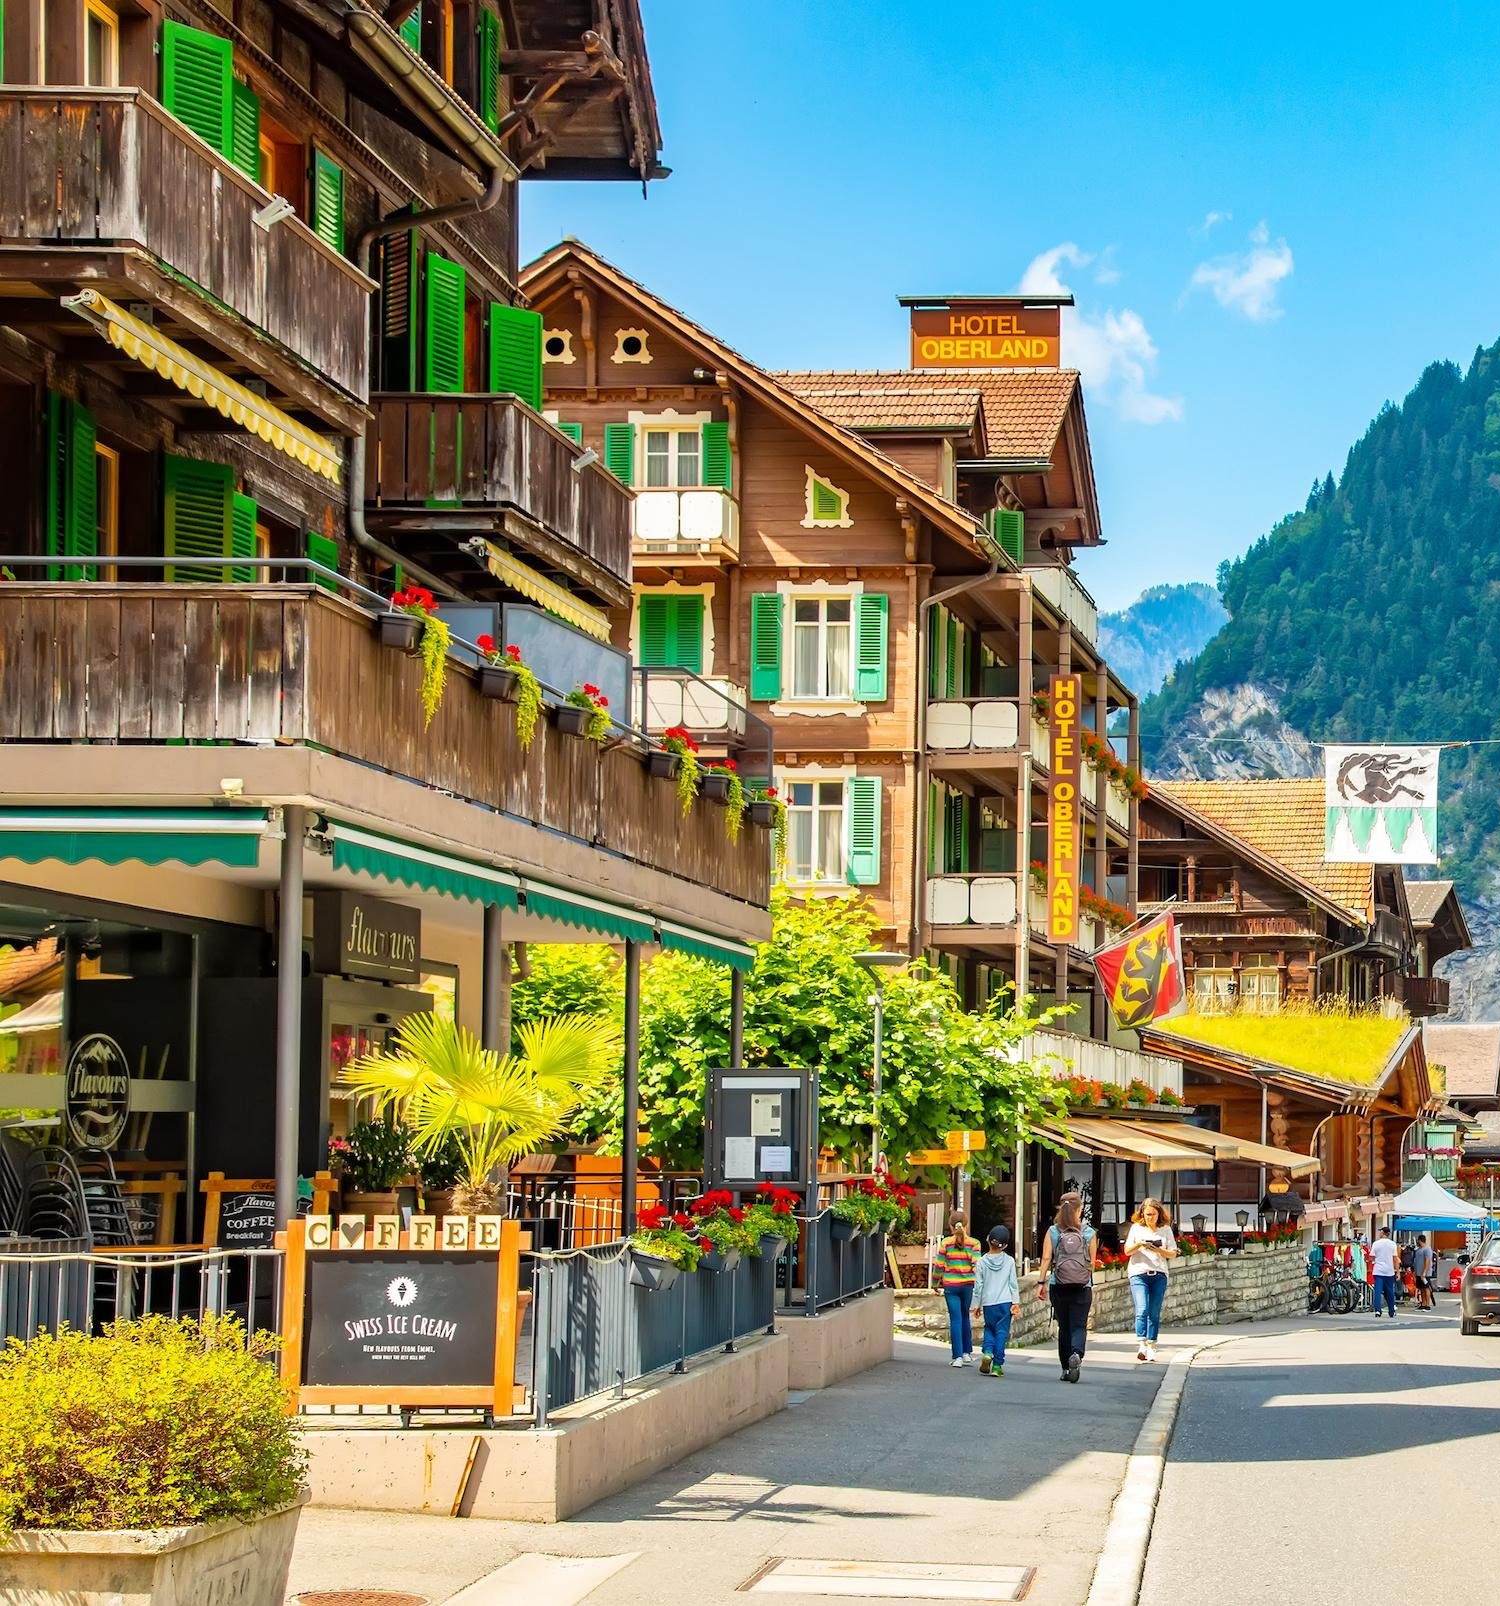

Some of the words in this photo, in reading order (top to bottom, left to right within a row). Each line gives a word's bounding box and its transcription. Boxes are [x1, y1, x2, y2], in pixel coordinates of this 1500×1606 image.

[949, 315, 1026, 335] HOTEL
[921, 339, 1049, 360] OBERLAND
[1054, 680, 1075, 775] HOTEL
[1053, 782, 1075, 936] OBERLAND
[70, 1063, 127, 1098] flavours
[243, 1196, 276, 1208] flavo
[226, 1215, 275, 1229] COFFEE
[226, 1231, 265, 1241] Breakfast
[344, 1317, 383, 1341] SWISS
[386, 1314, 408, 1335] ICE
[412, 1314, 458, 1342] CREAM
